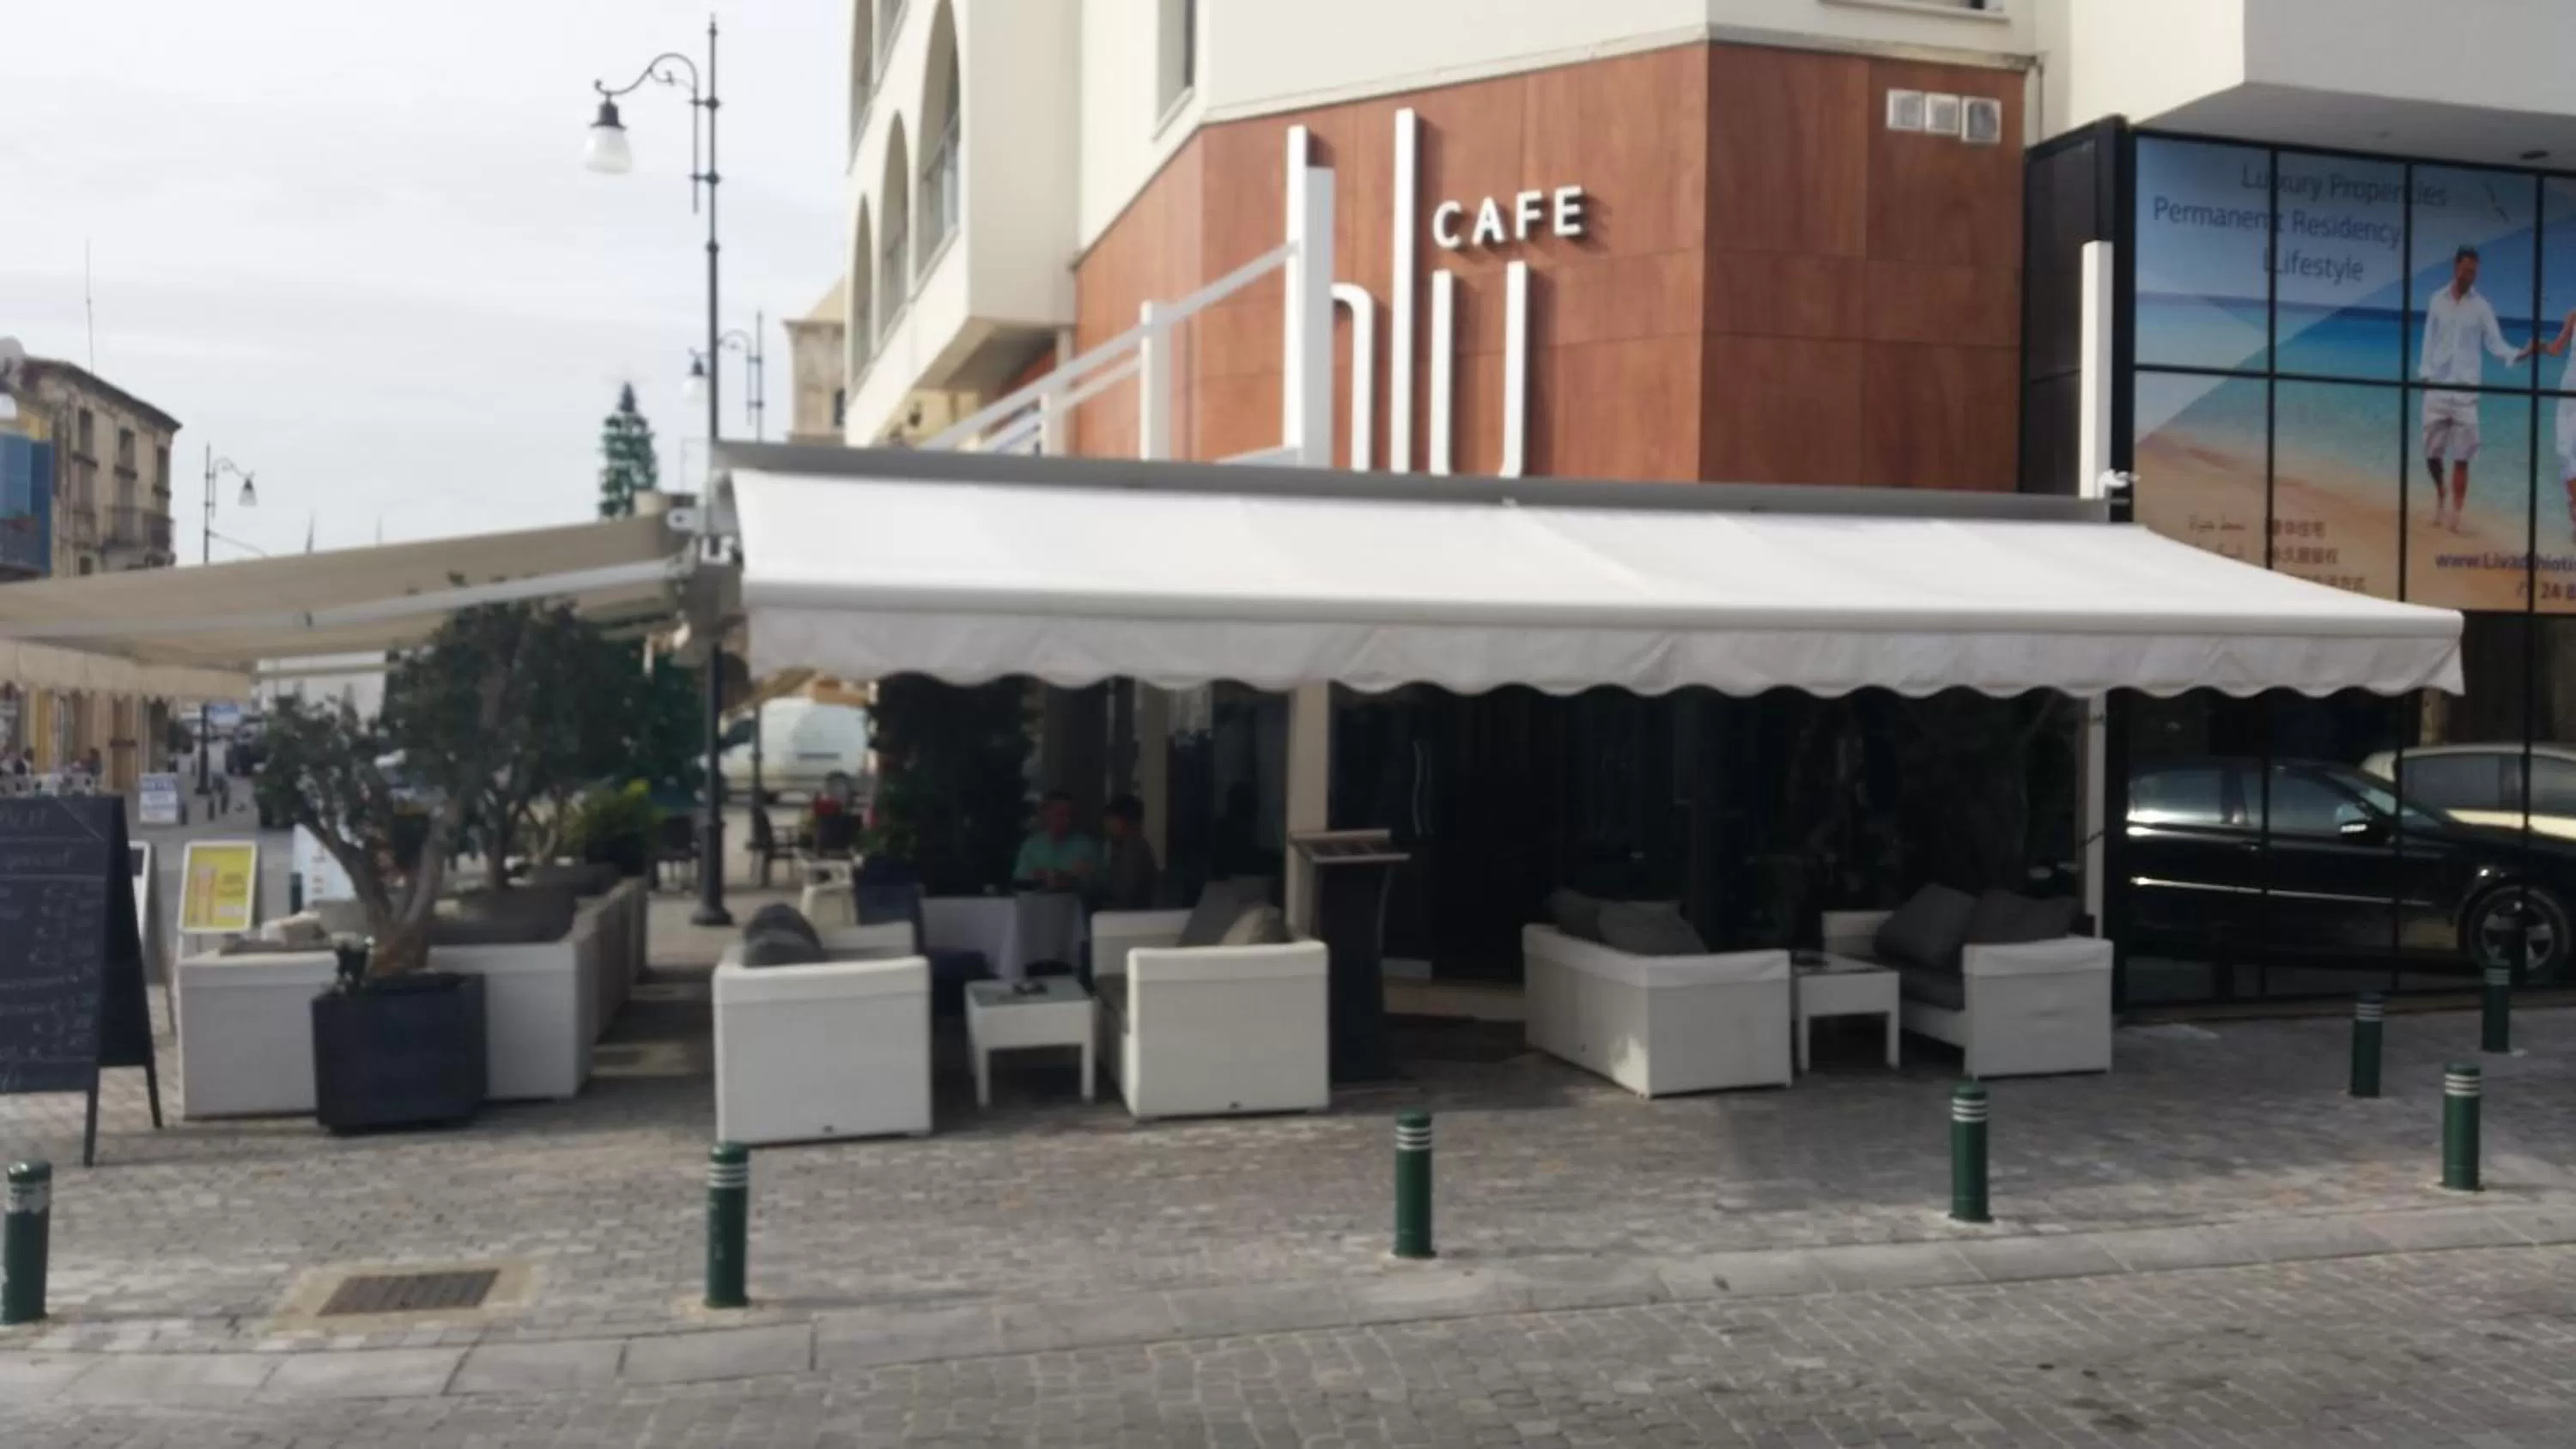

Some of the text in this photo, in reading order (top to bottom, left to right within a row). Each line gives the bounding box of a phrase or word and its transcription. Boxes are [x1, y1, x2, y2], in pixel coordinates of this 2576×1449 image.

[2242, 164, 2447, 207] Luury Properies
[1433, 186, 1582, 248] CAFE
[2154, 196, 2402, 250] Permanent Residency
[2263, 247, 2364, 284] Lifestyle
